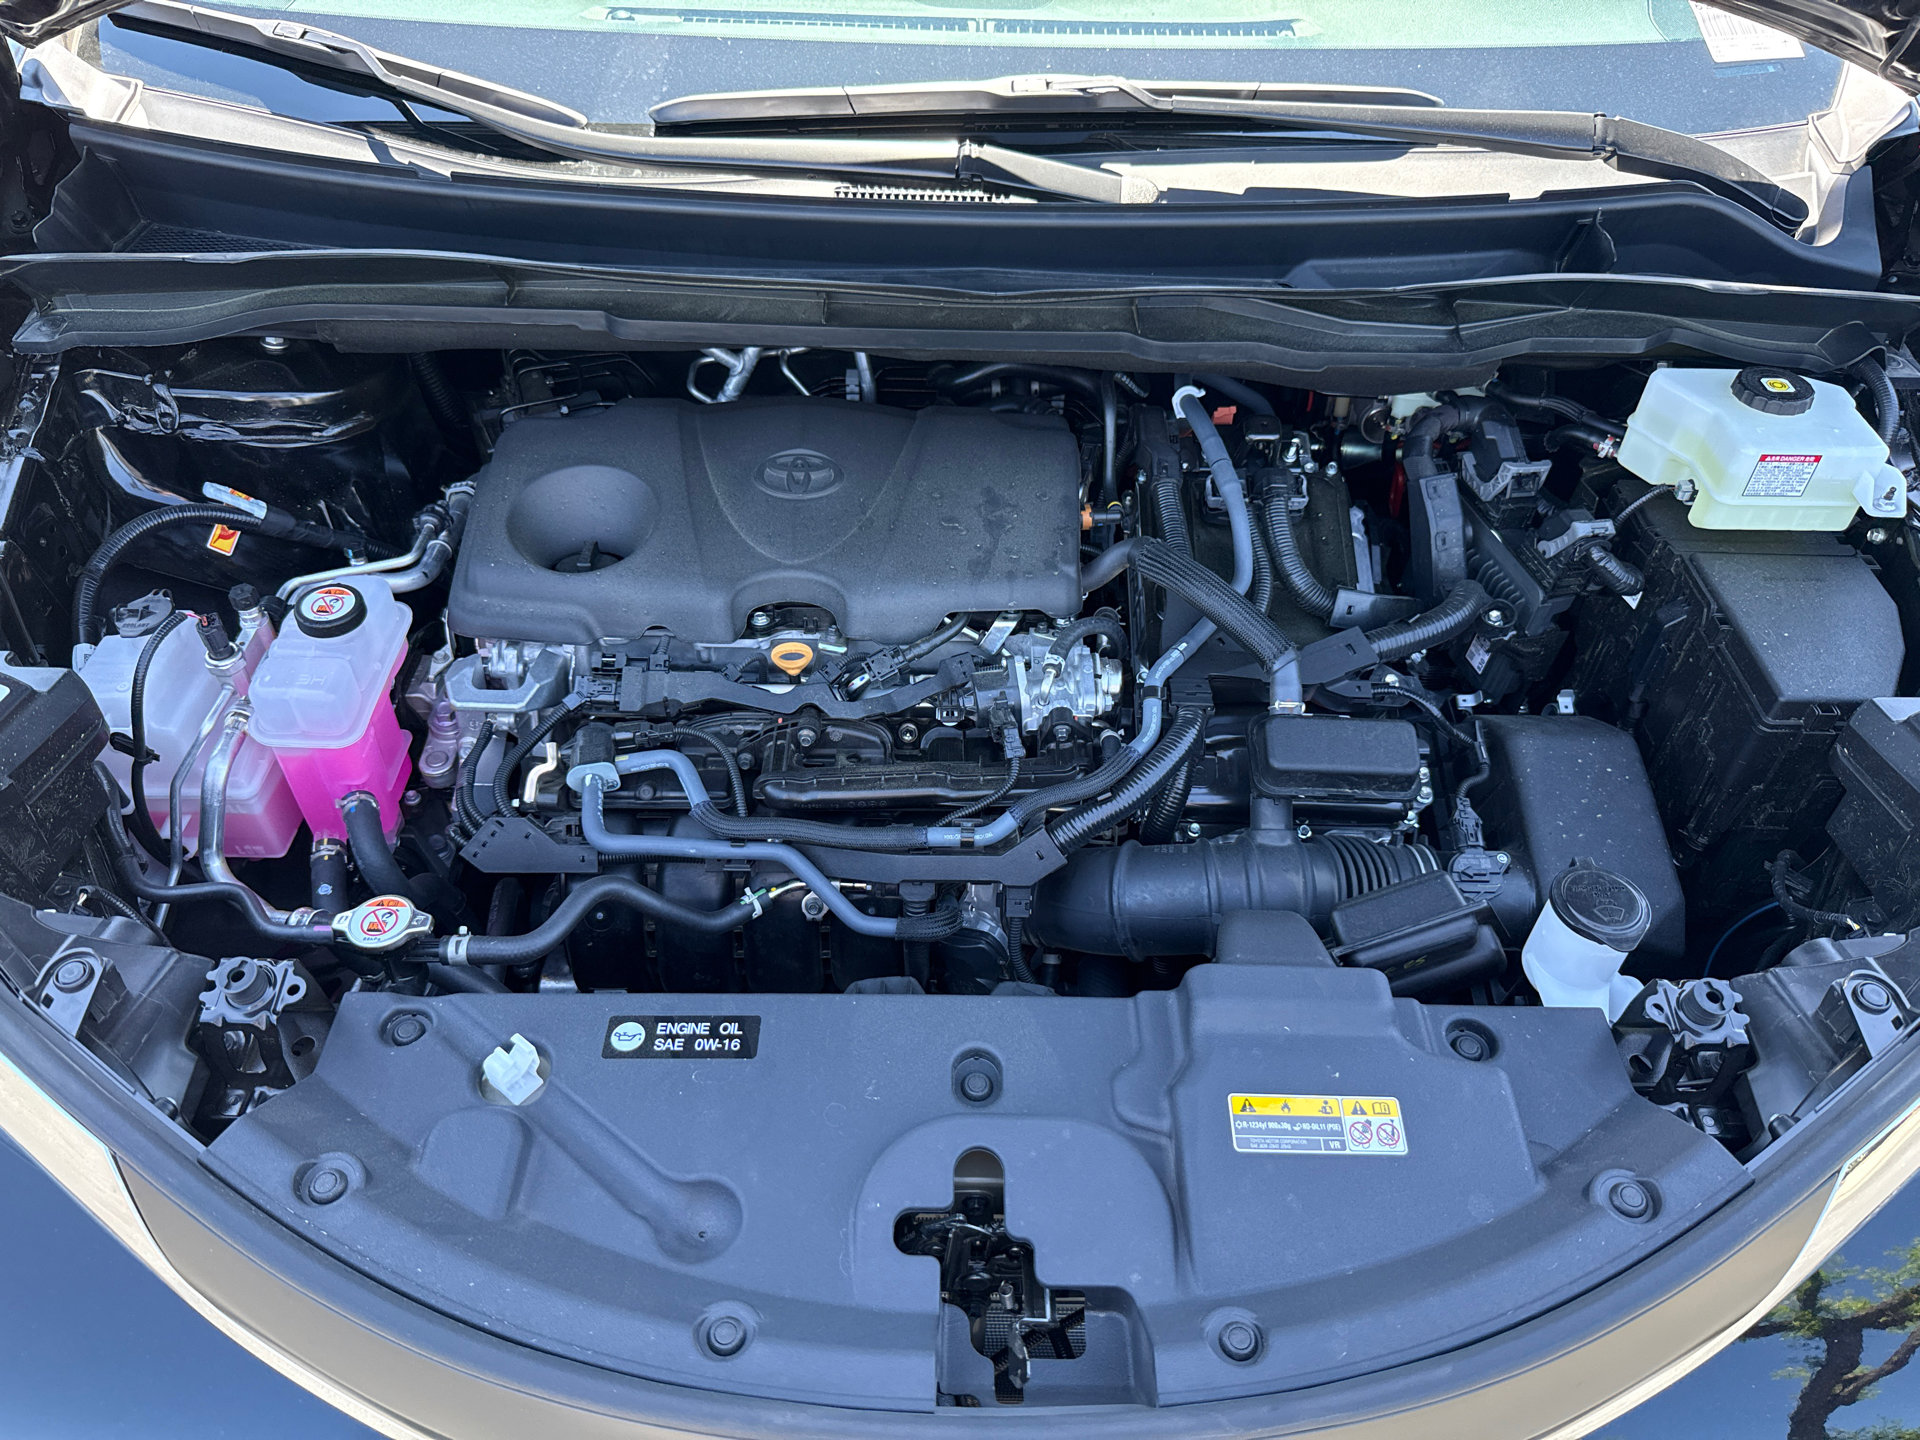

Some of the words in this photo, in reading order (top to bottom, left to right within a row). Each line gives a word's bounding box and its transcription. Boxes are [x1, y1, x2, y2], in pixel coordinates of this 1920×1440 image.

[656, 1022, 711, 1035] ENGINE
[719, 1022, 743, 1035] OIL
[653, 1038, 685, 1051] SAE
[694, 1038, 741, 1051] 0W-16
[1242, 1121, 1267, 1131] R-1234yf
[1328, 1140, 1341, 1149] VR
